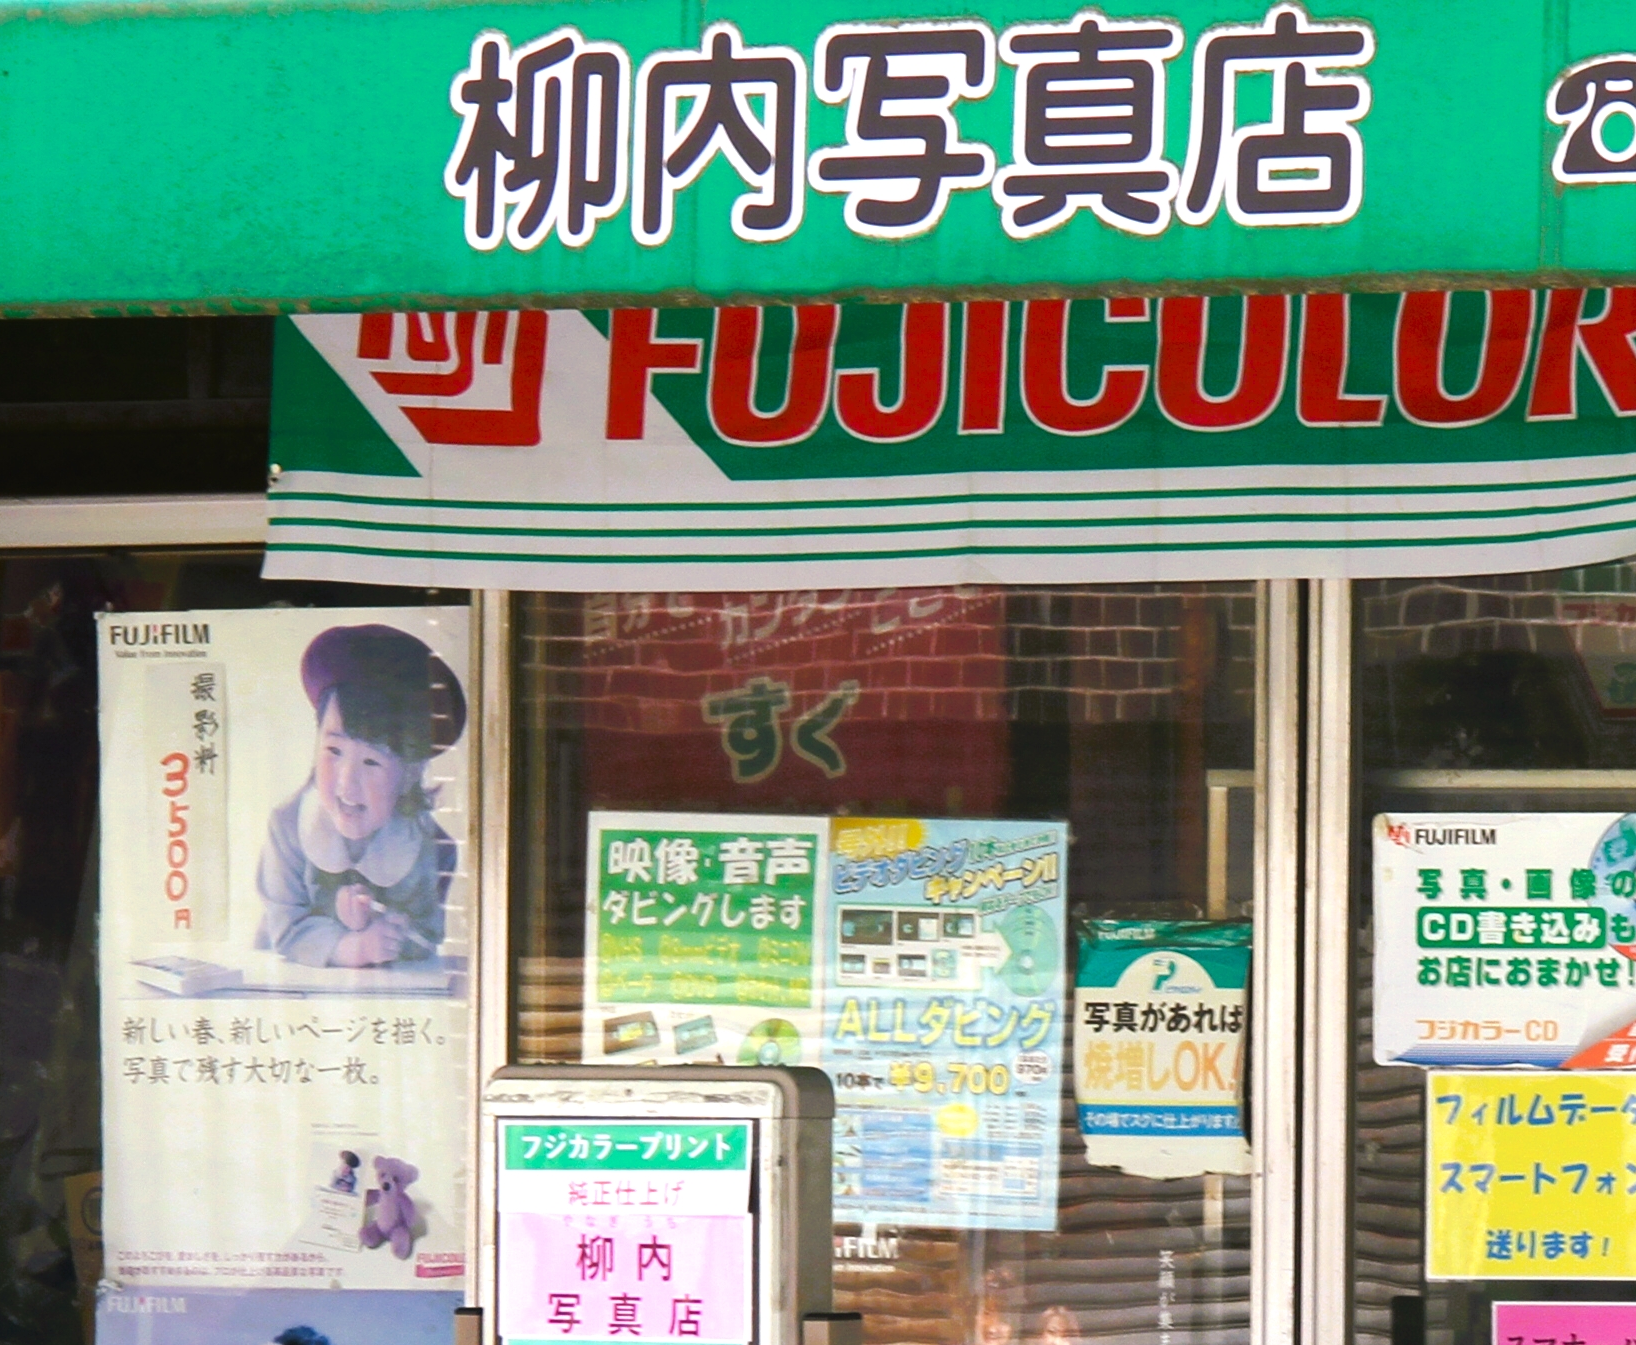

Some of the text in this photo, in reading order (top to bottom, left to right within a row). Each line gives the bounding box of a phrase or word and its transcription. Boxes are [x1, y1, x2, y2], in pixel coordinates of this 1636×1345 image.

[445, 3, 1375, 252] 柳内写真店
[110, 624, 211, 646] FUJIFILM
[1415, 828, 1497, 846] FUJIFILM
[606, 836, 814, 886] 映像・音声
[602, 888, 807, 931] ダビングします
[1421, 911, 1636, 945] CD書き込みも
[1083, 1000, 1243, 1034] 写真があれば
[1415, 1019, 1559, 1042] フジカラーCD
[122, 1055, 380, 1085] 写真で残す大切な一枚。
[520, 1133, 733, 1163] フジカラープリント
[567, 1179, 685, 1207] 純正仕上げ
[575, 1233, 675, 1282] 柳内
[547, 1291, 705, 1338] 写真店
